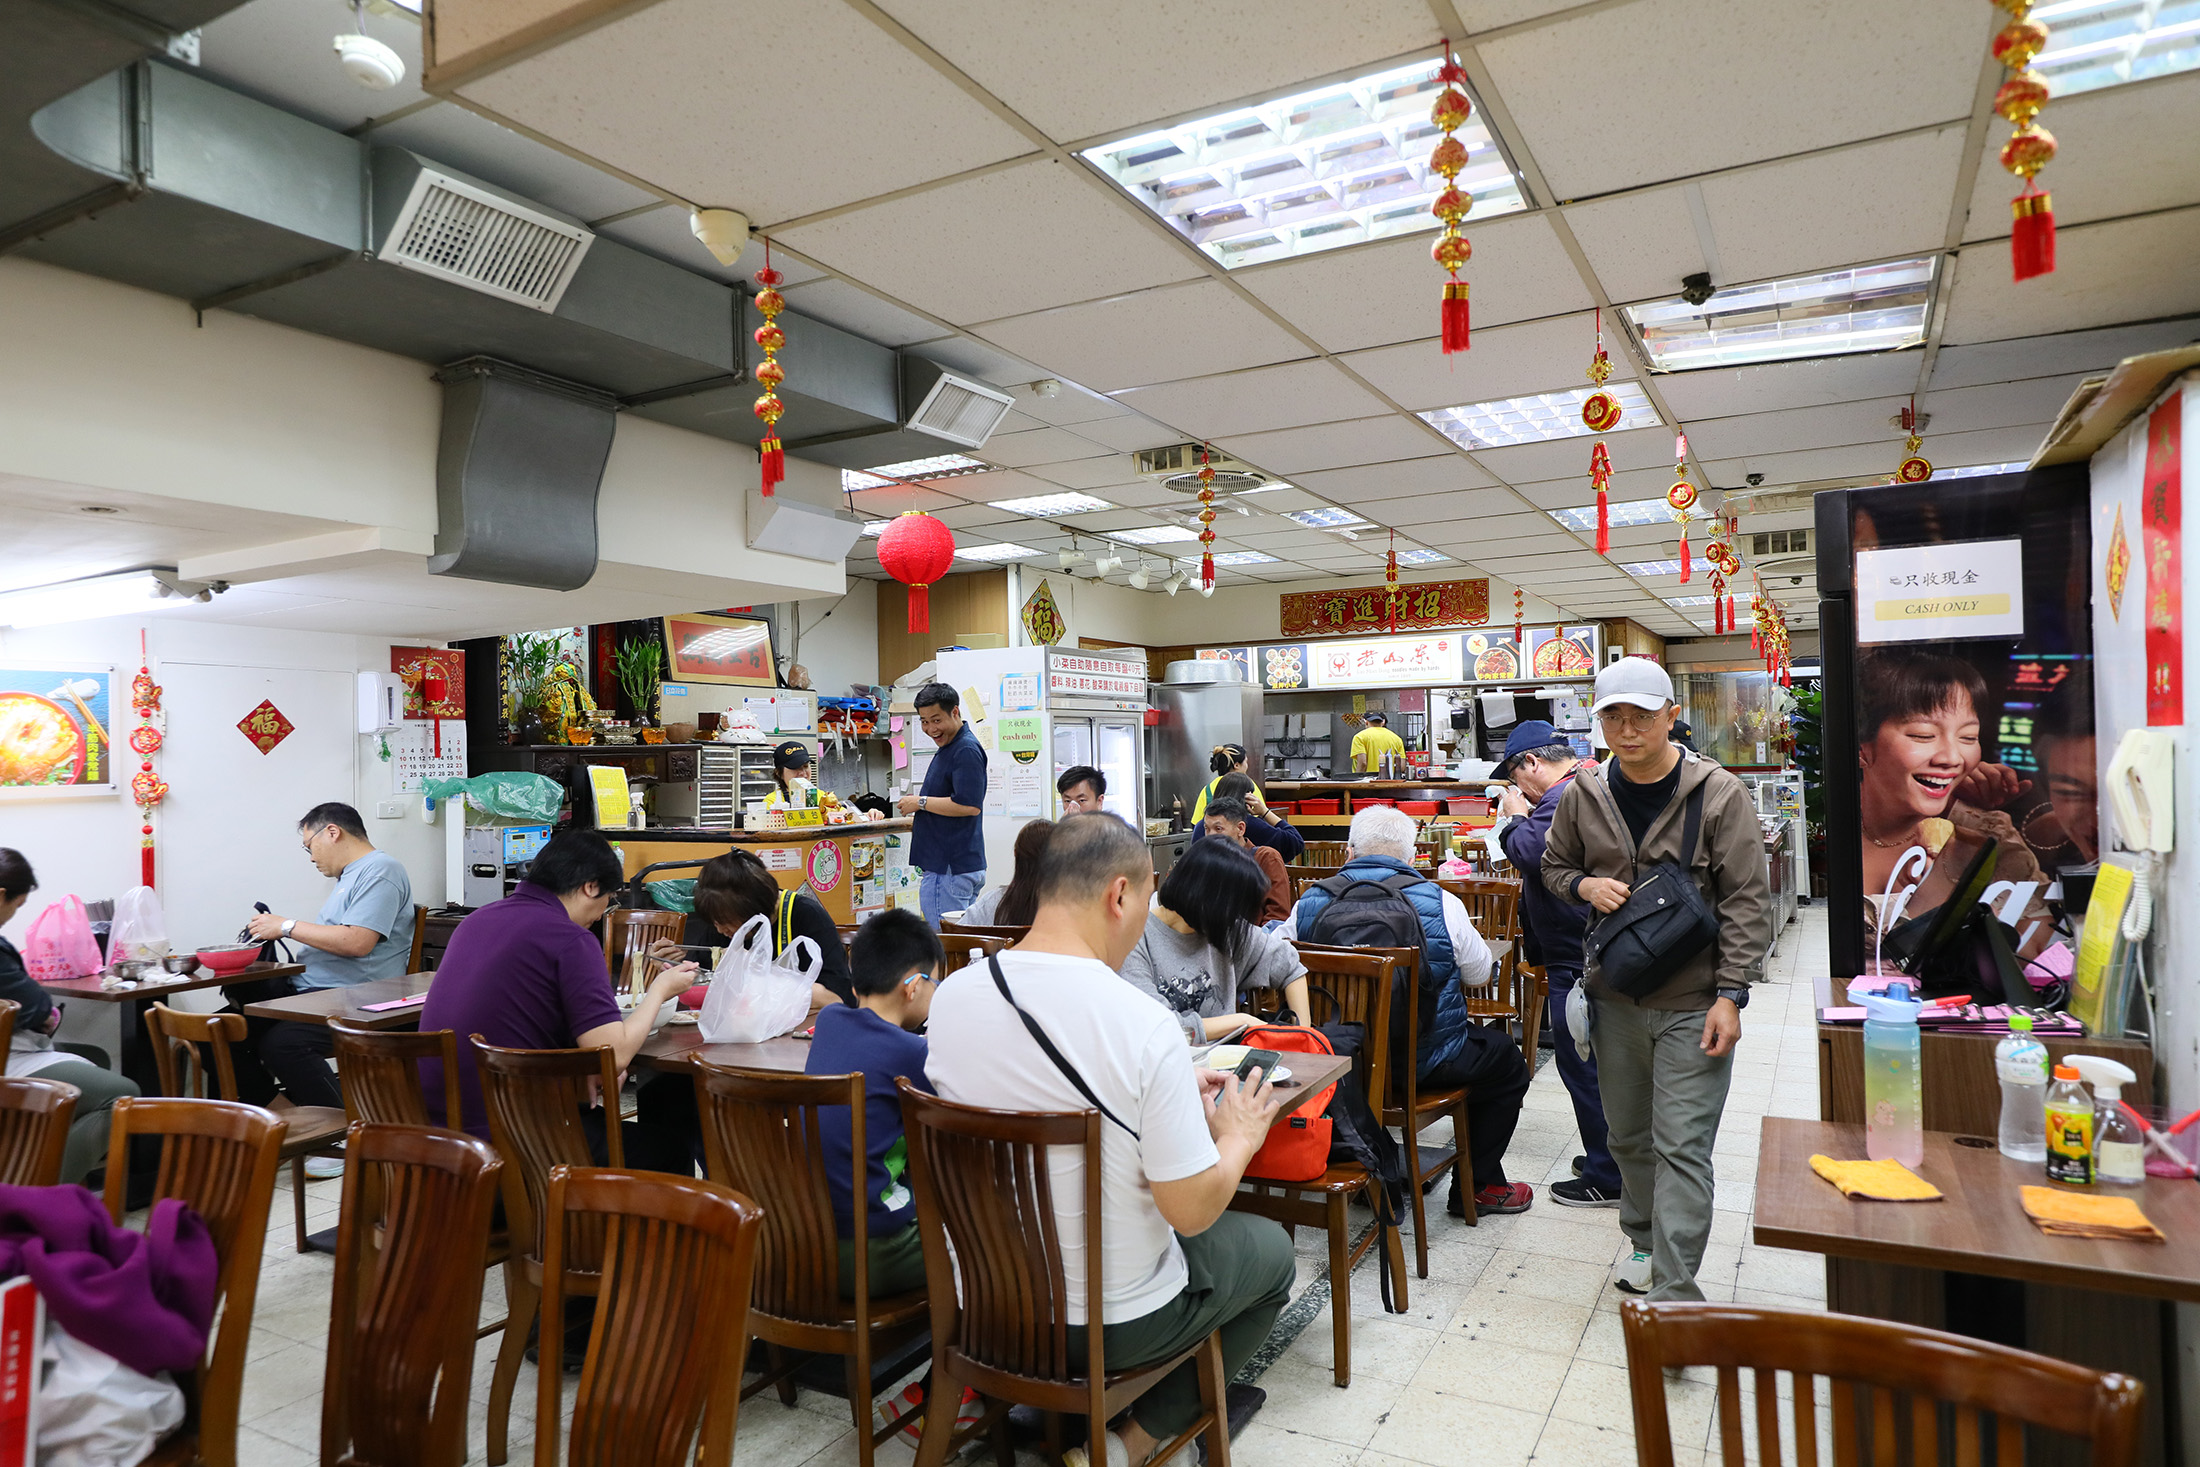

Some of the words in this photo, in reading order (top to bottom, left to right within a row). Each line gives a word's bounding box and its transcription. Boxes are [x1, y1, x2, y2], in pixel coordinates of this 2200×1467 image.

[1587, 400, 1604, 421] 福
[1906, 463, 1923, 478] 福
[1674, 485, 1690, 502] 福
[1904, 569, 1980, 588] 只收現金
[1905, 602, 1939, 614] CASH
[1943, 600, 1980, 612] ONLY
[1034, 600, 1053, 642] 福
[1053, 656, 1141, 675] 小菜自助隨意自取每盤40元
[250, 706, 280, 735] 福
[1002, 733, 1020, 741] cash
[1022, 732, 1037, 741] only
